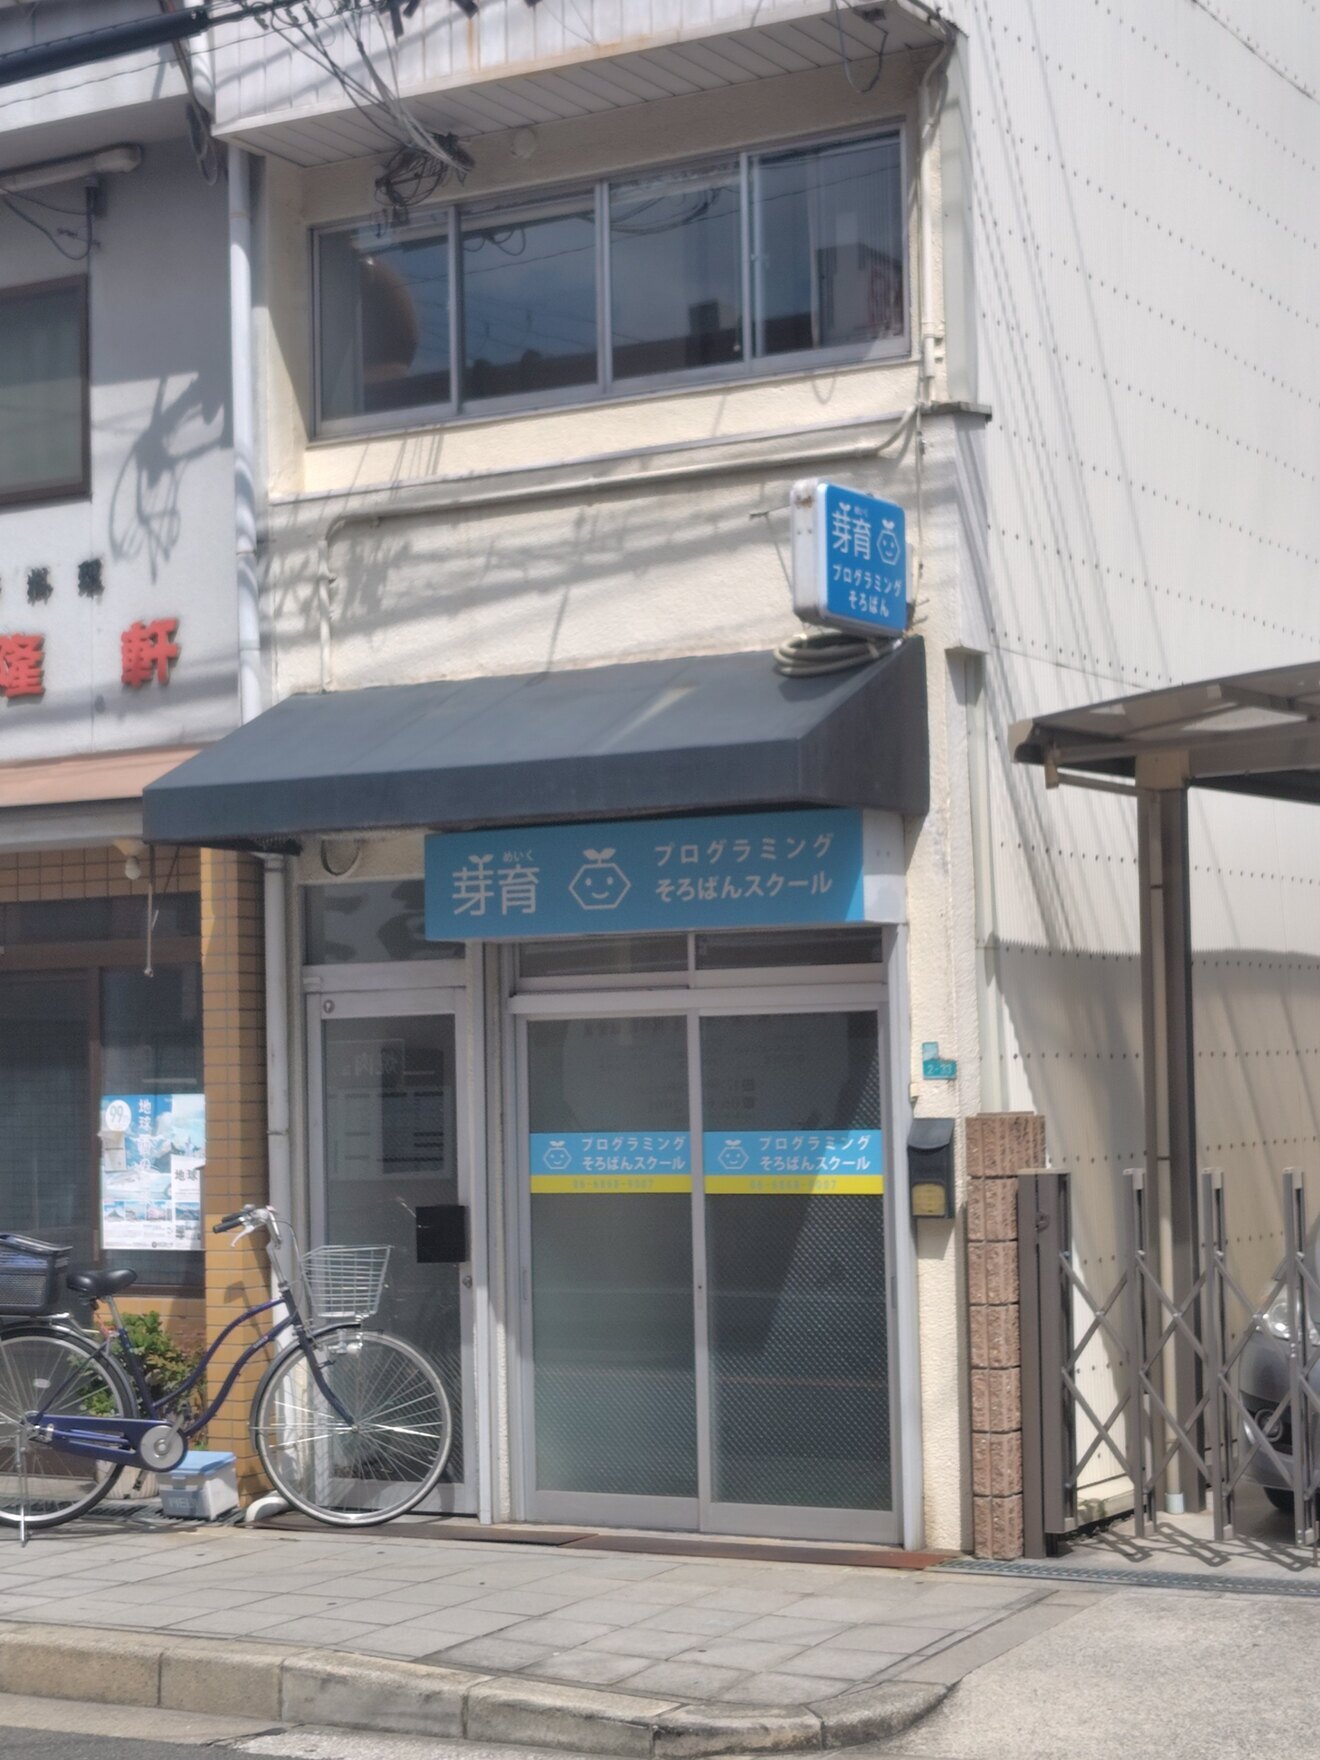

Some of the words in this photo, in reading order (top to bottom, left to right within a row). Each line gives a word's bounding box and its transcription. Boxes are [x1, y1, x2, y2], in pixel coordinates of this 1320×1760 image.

[832, 502, 871, 561] 芽育
[832, 564, 901, 597] プログラミング
[848, 590, 890, 617] そろばん
[655, 832, 835, 867] プログラミング
[452, 855, 540, 917] 芽育
[655, 869, 833, 903] そろばんスクール
[581, 1136, 686, 1152] プログラミング
[759, 1134, 871, 1152] プログラミング
[582, 1155, 686, 1171] そろばんスクール
[759, 1155, 871, 1171] そろばんスクール
